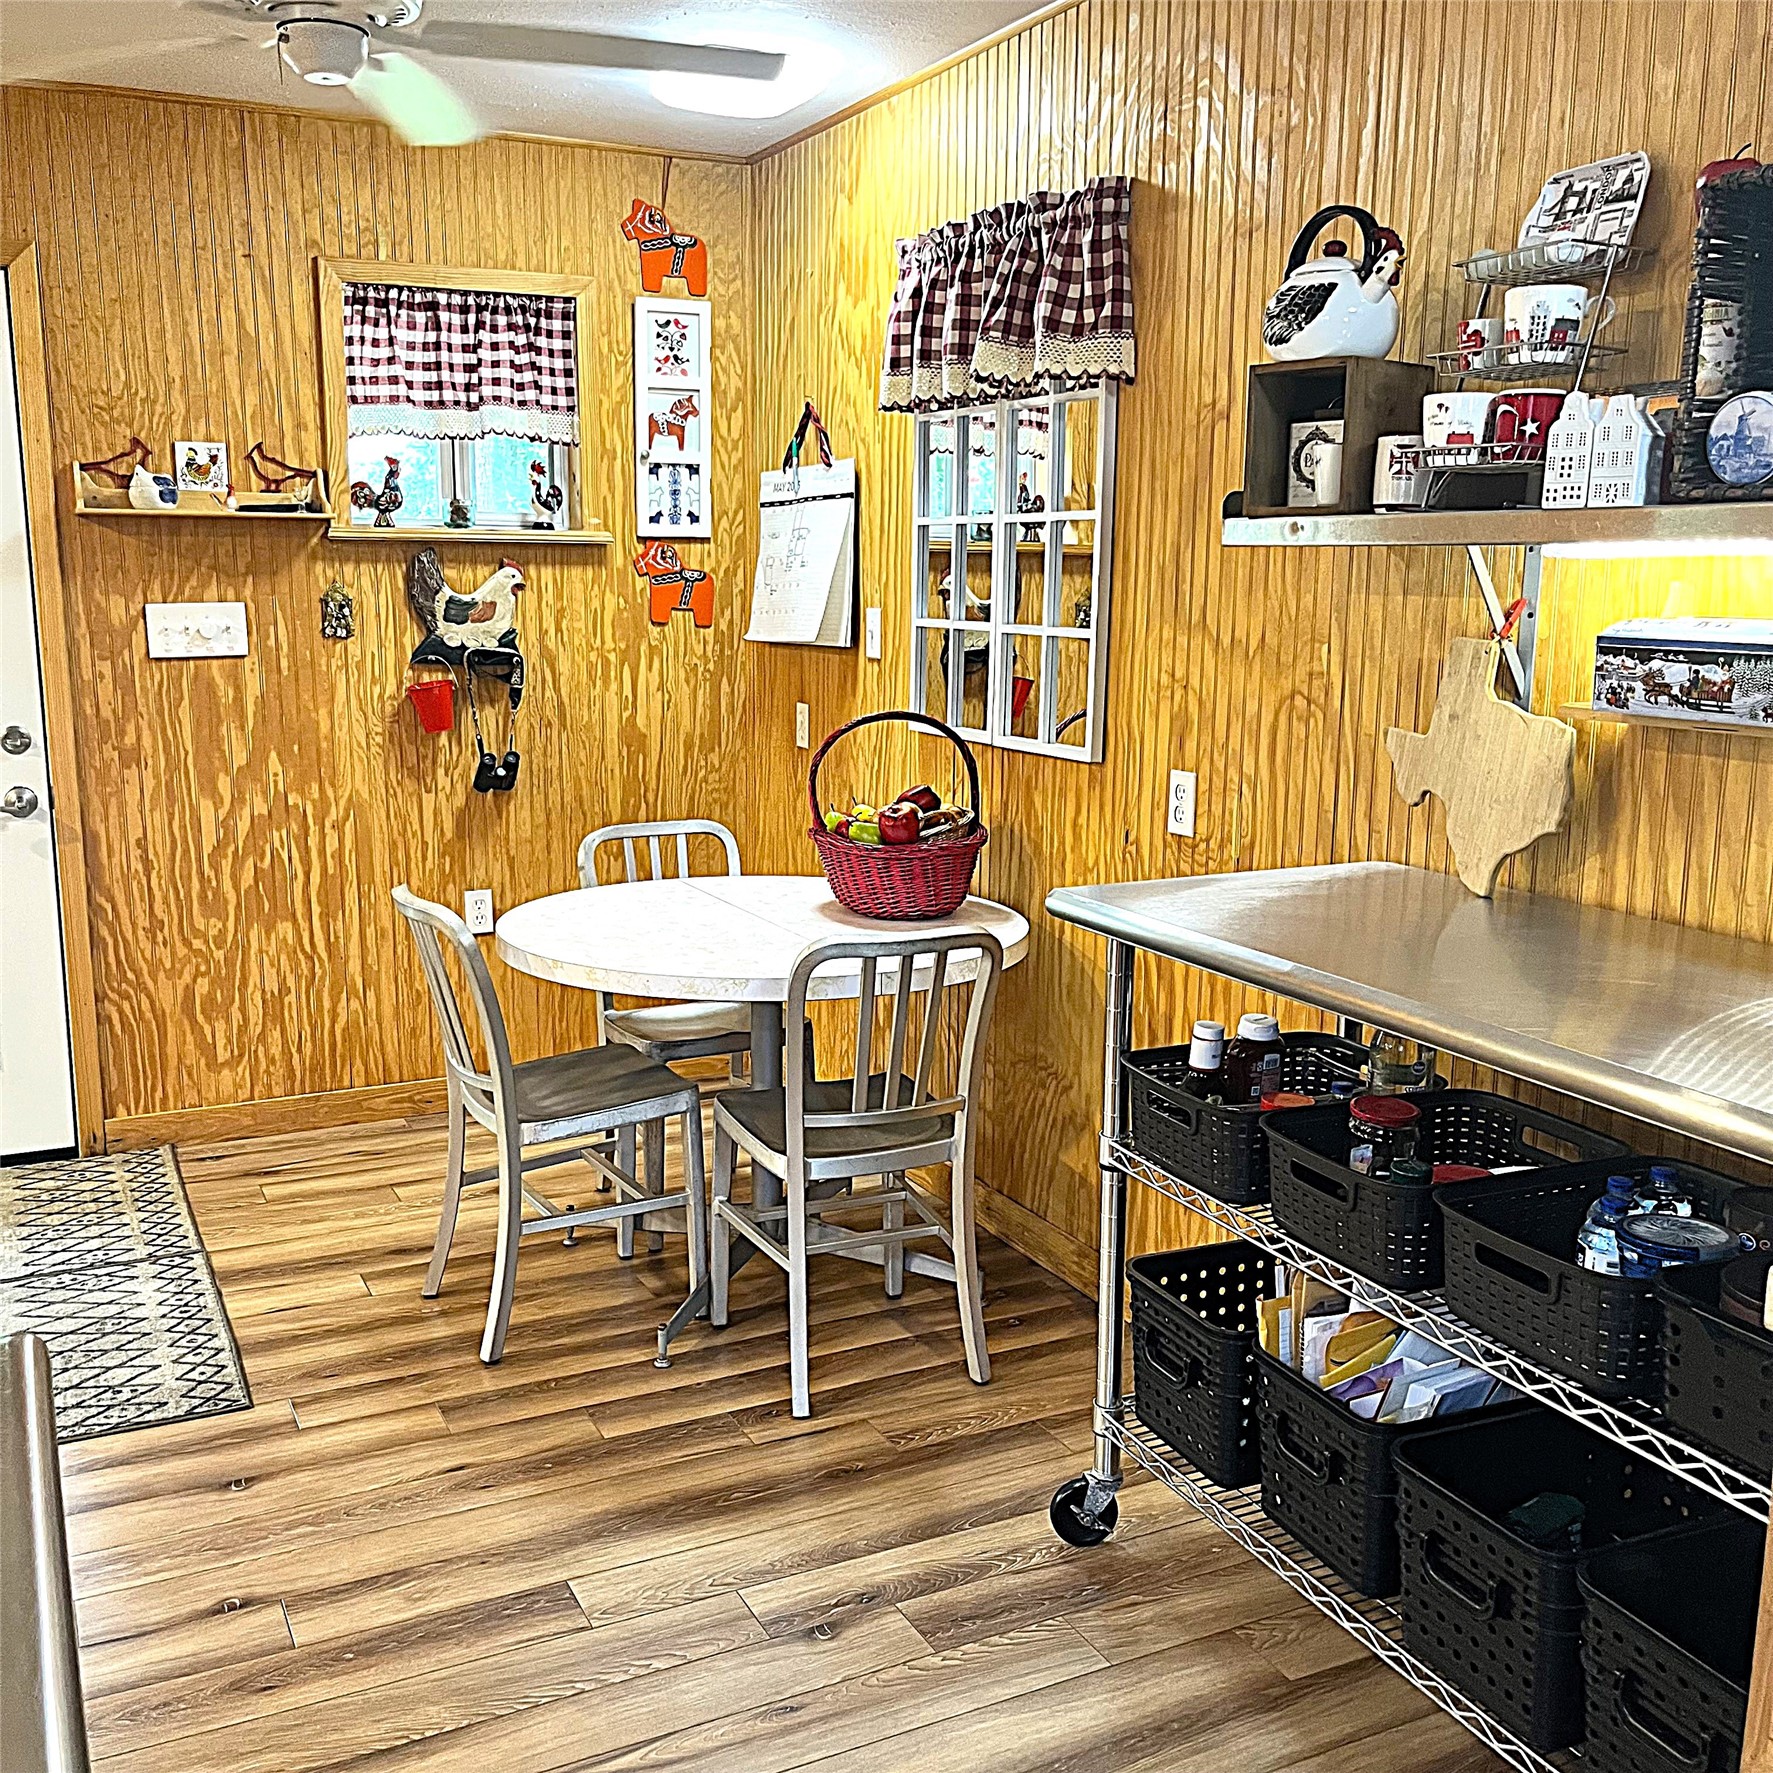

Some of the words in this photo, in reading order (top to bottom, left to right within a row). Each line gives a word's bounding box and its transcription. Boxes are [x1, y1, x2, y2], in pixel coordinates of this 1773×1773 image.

[1595, 165, 1613, 210] LONDON
[773, 483, 786, 493] MAY
[787, 480, 801, 492] 205
